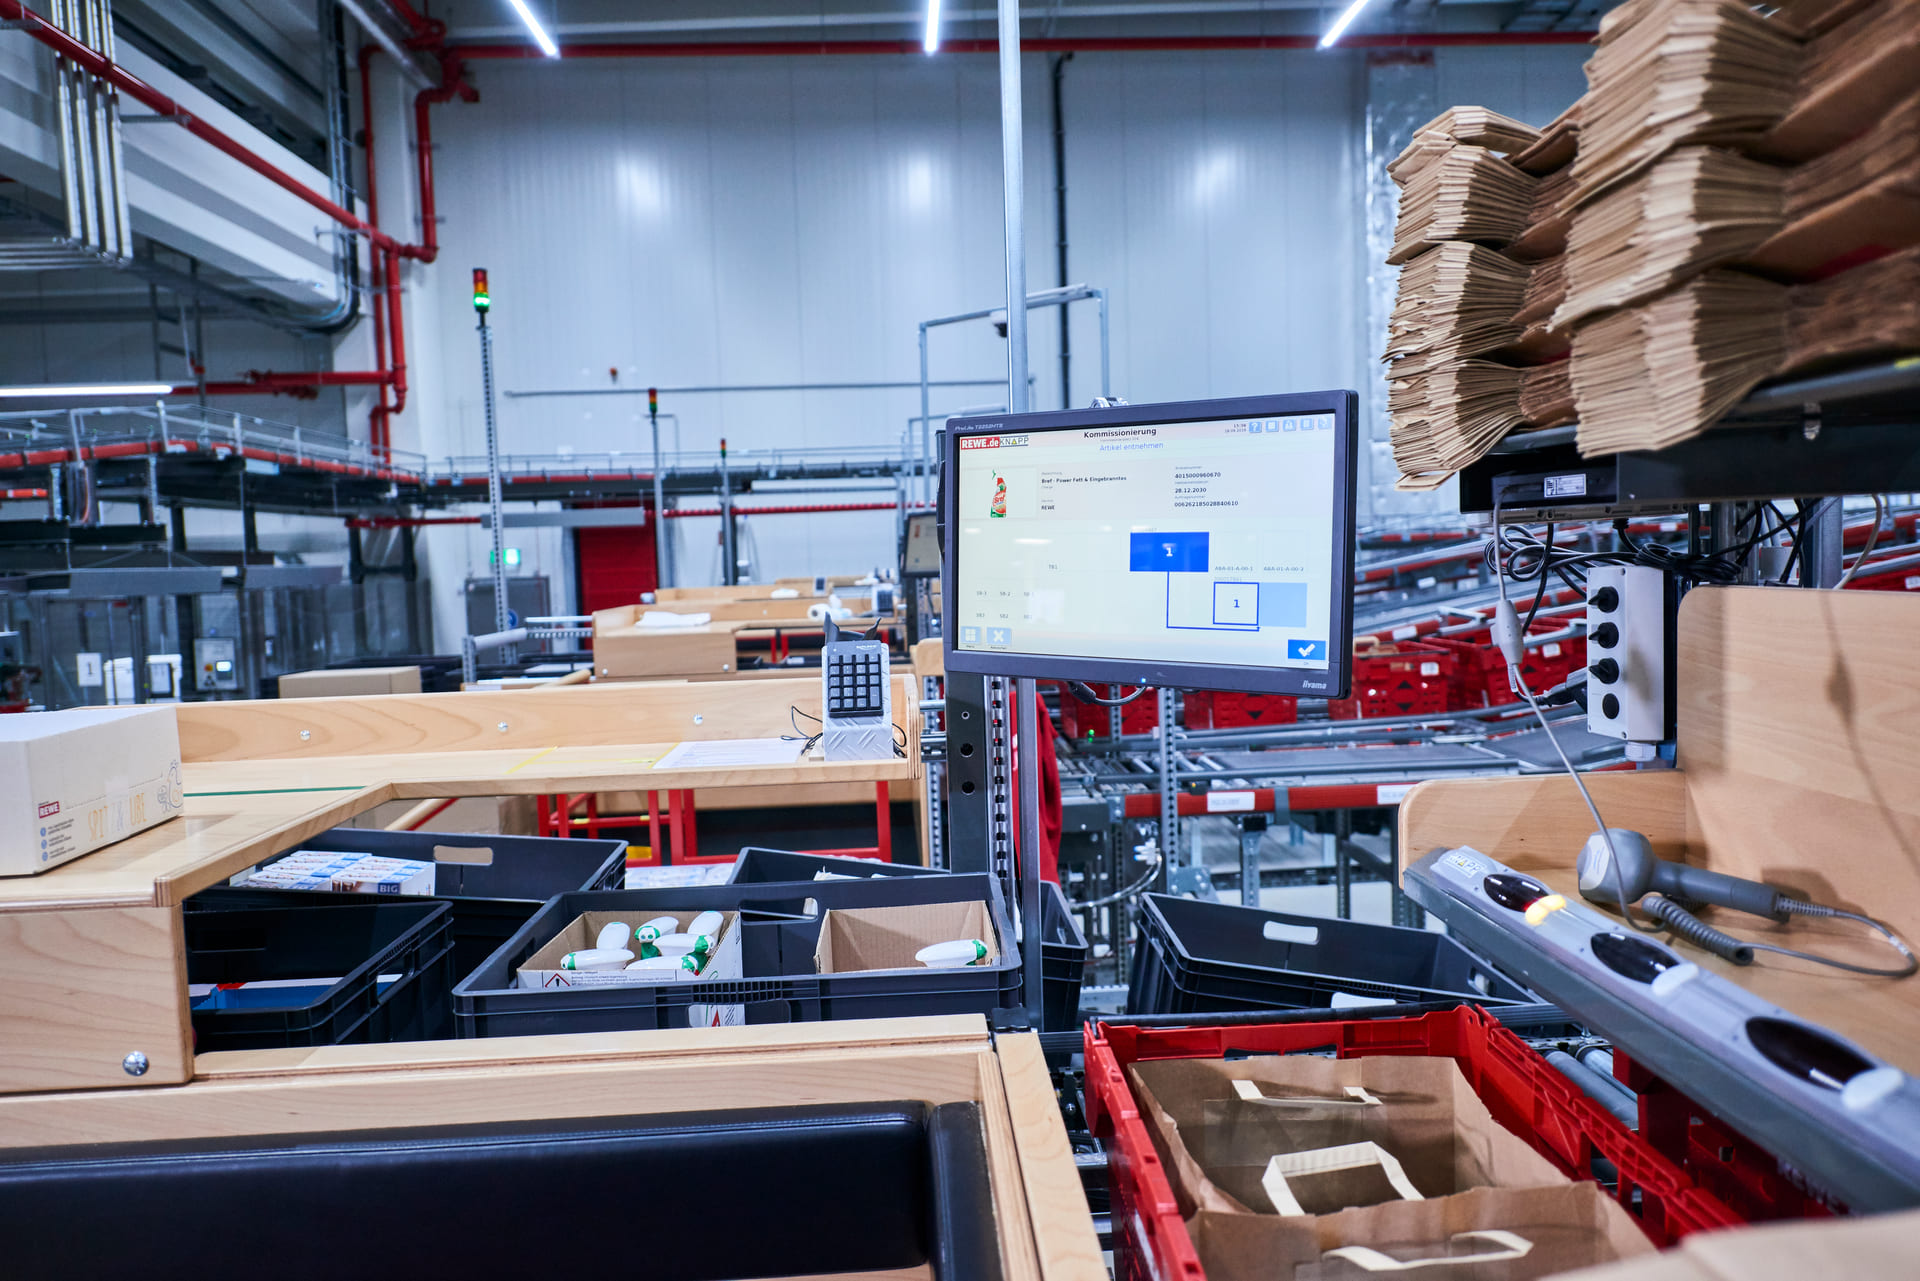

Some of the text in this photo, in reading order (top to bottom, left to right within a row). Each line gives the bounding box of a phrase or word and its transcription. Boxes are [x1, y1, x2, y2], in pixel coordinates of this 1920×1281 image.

[1083, 428, 1157, 439] Kommissionierung
[962, 438, 999, 449] REWE.de
[1000, 437, 1029, 446] KNAPP
[1100, 442, 1164, 452] Artikel entnehmen
[1233, 599, 1240, 609] 1
[40, 803, 60, 818] REWE
[379, 884, 398, 893] BIG
